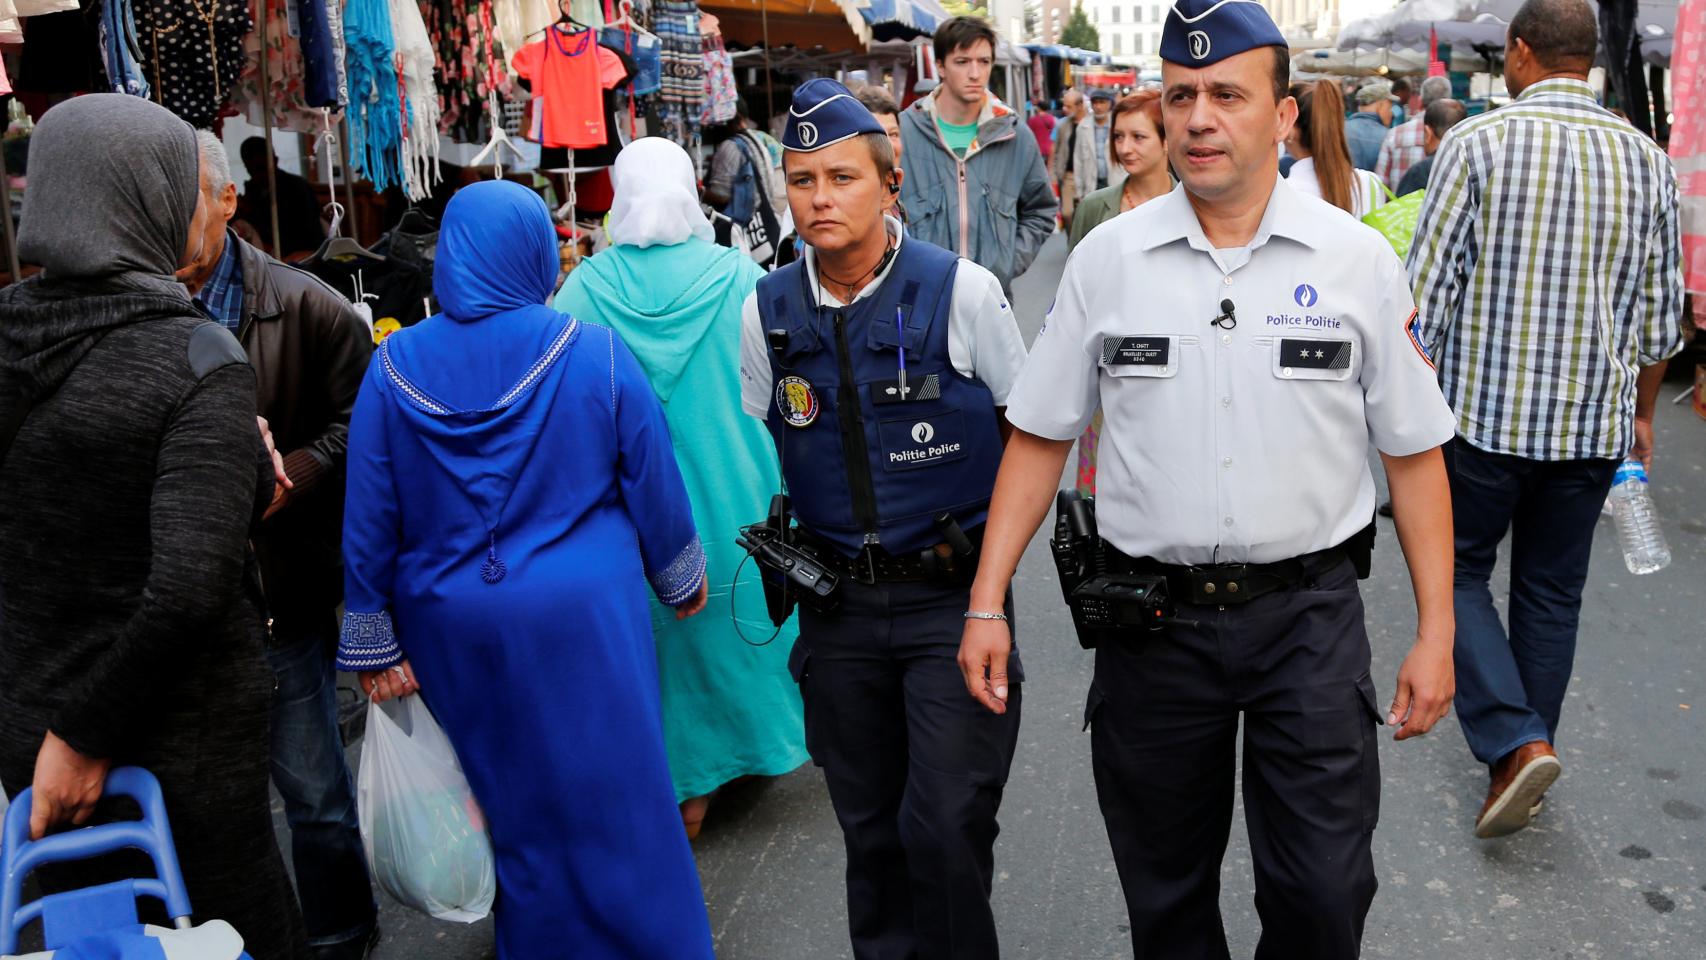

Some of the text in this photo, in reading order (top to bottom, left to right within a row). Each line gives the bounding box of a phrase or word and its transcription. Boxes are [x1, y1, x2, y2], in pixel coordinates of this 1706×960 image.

[1266, 314, 1341, 329] Police Politie
[889, 442, 960, 463] Politie Police
